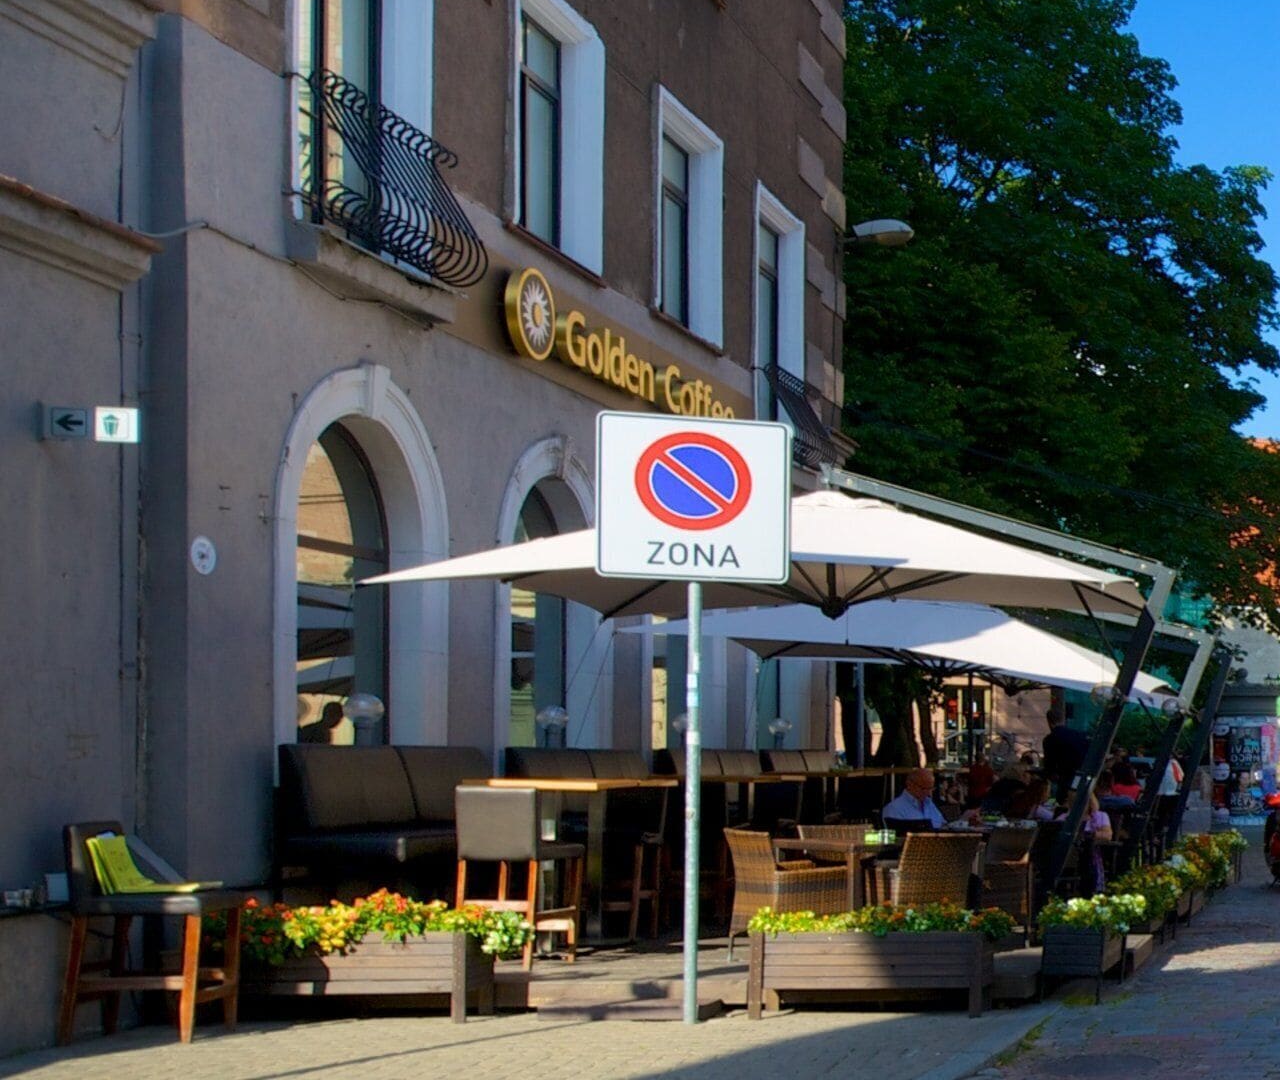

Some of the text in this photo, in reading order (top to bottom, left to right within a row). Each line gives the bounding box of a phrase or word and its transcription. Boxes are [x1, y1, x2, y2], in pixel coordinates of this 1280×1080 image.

[565, 310, 735, 418] Golden Coffe
[647, 541, 740, 568] ZONA
